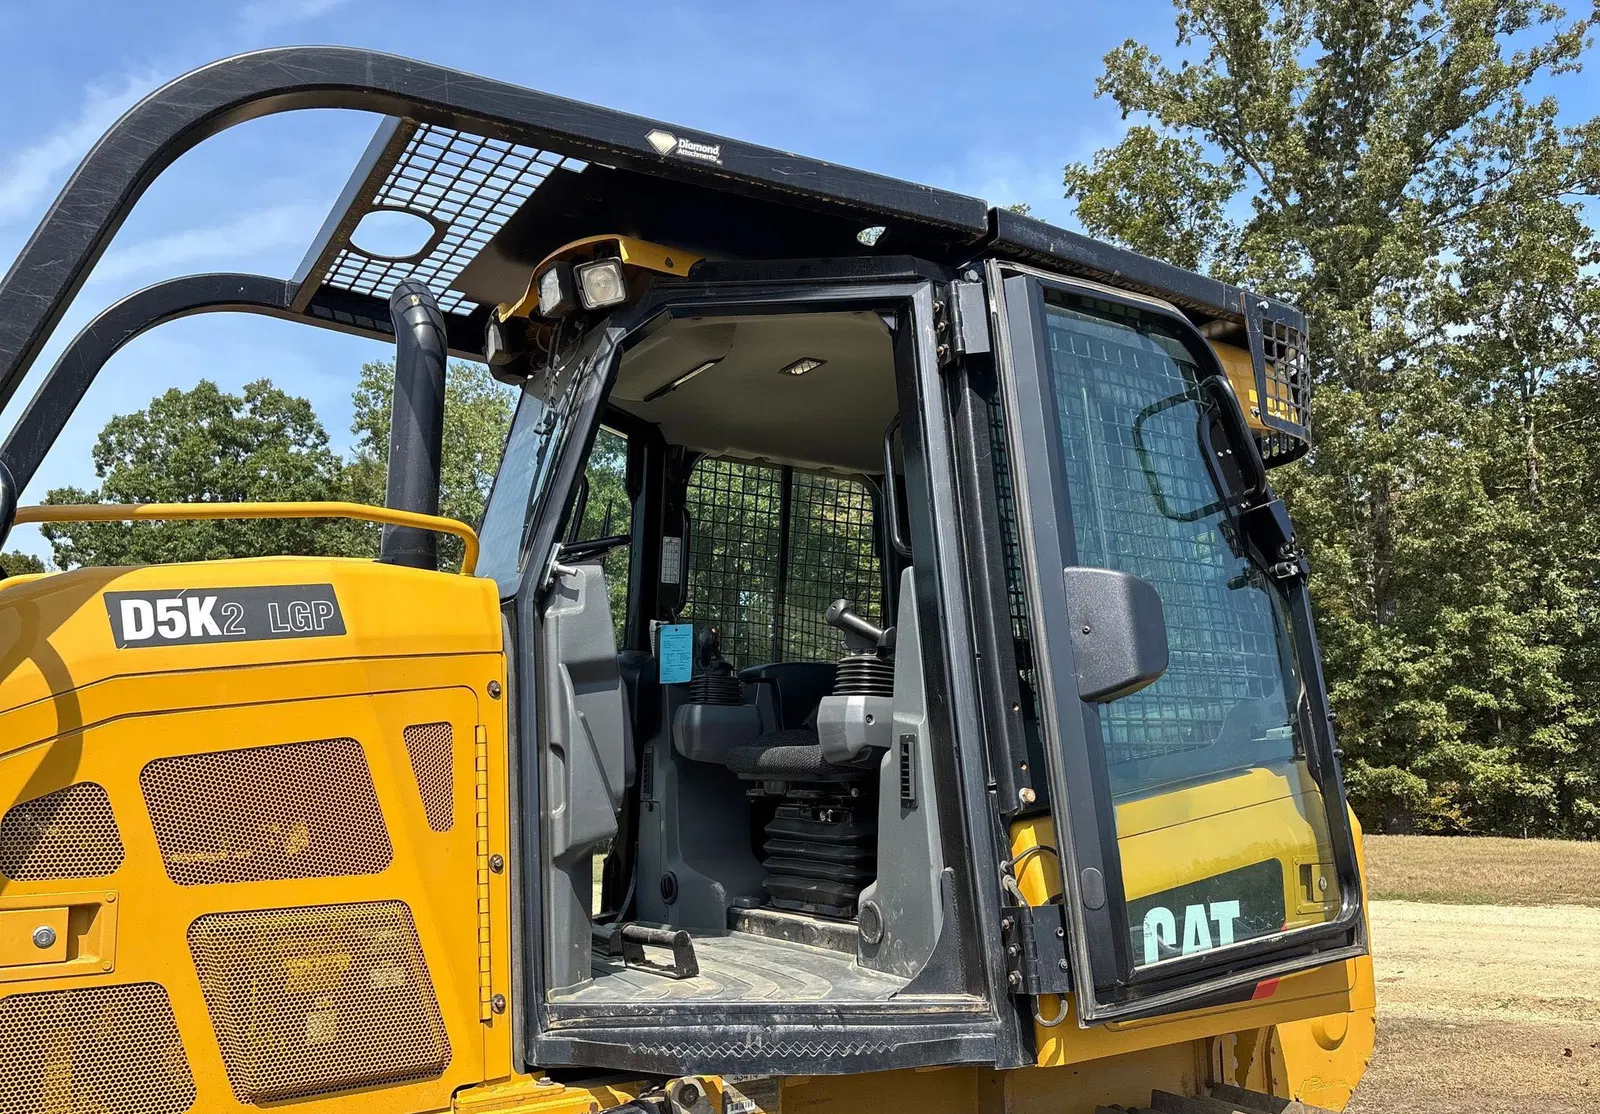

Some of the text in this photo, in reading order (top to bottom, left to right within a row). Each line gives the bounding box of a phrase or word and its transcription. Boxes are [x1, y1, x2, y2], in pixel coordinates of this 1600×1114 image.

[677, 148, 718, 162] Attachments
[678, 138, 719, 155] Diamond
[120, 596, 334, 641] D5K2 LGP
[1144, 900, 1240, 965] CAT
